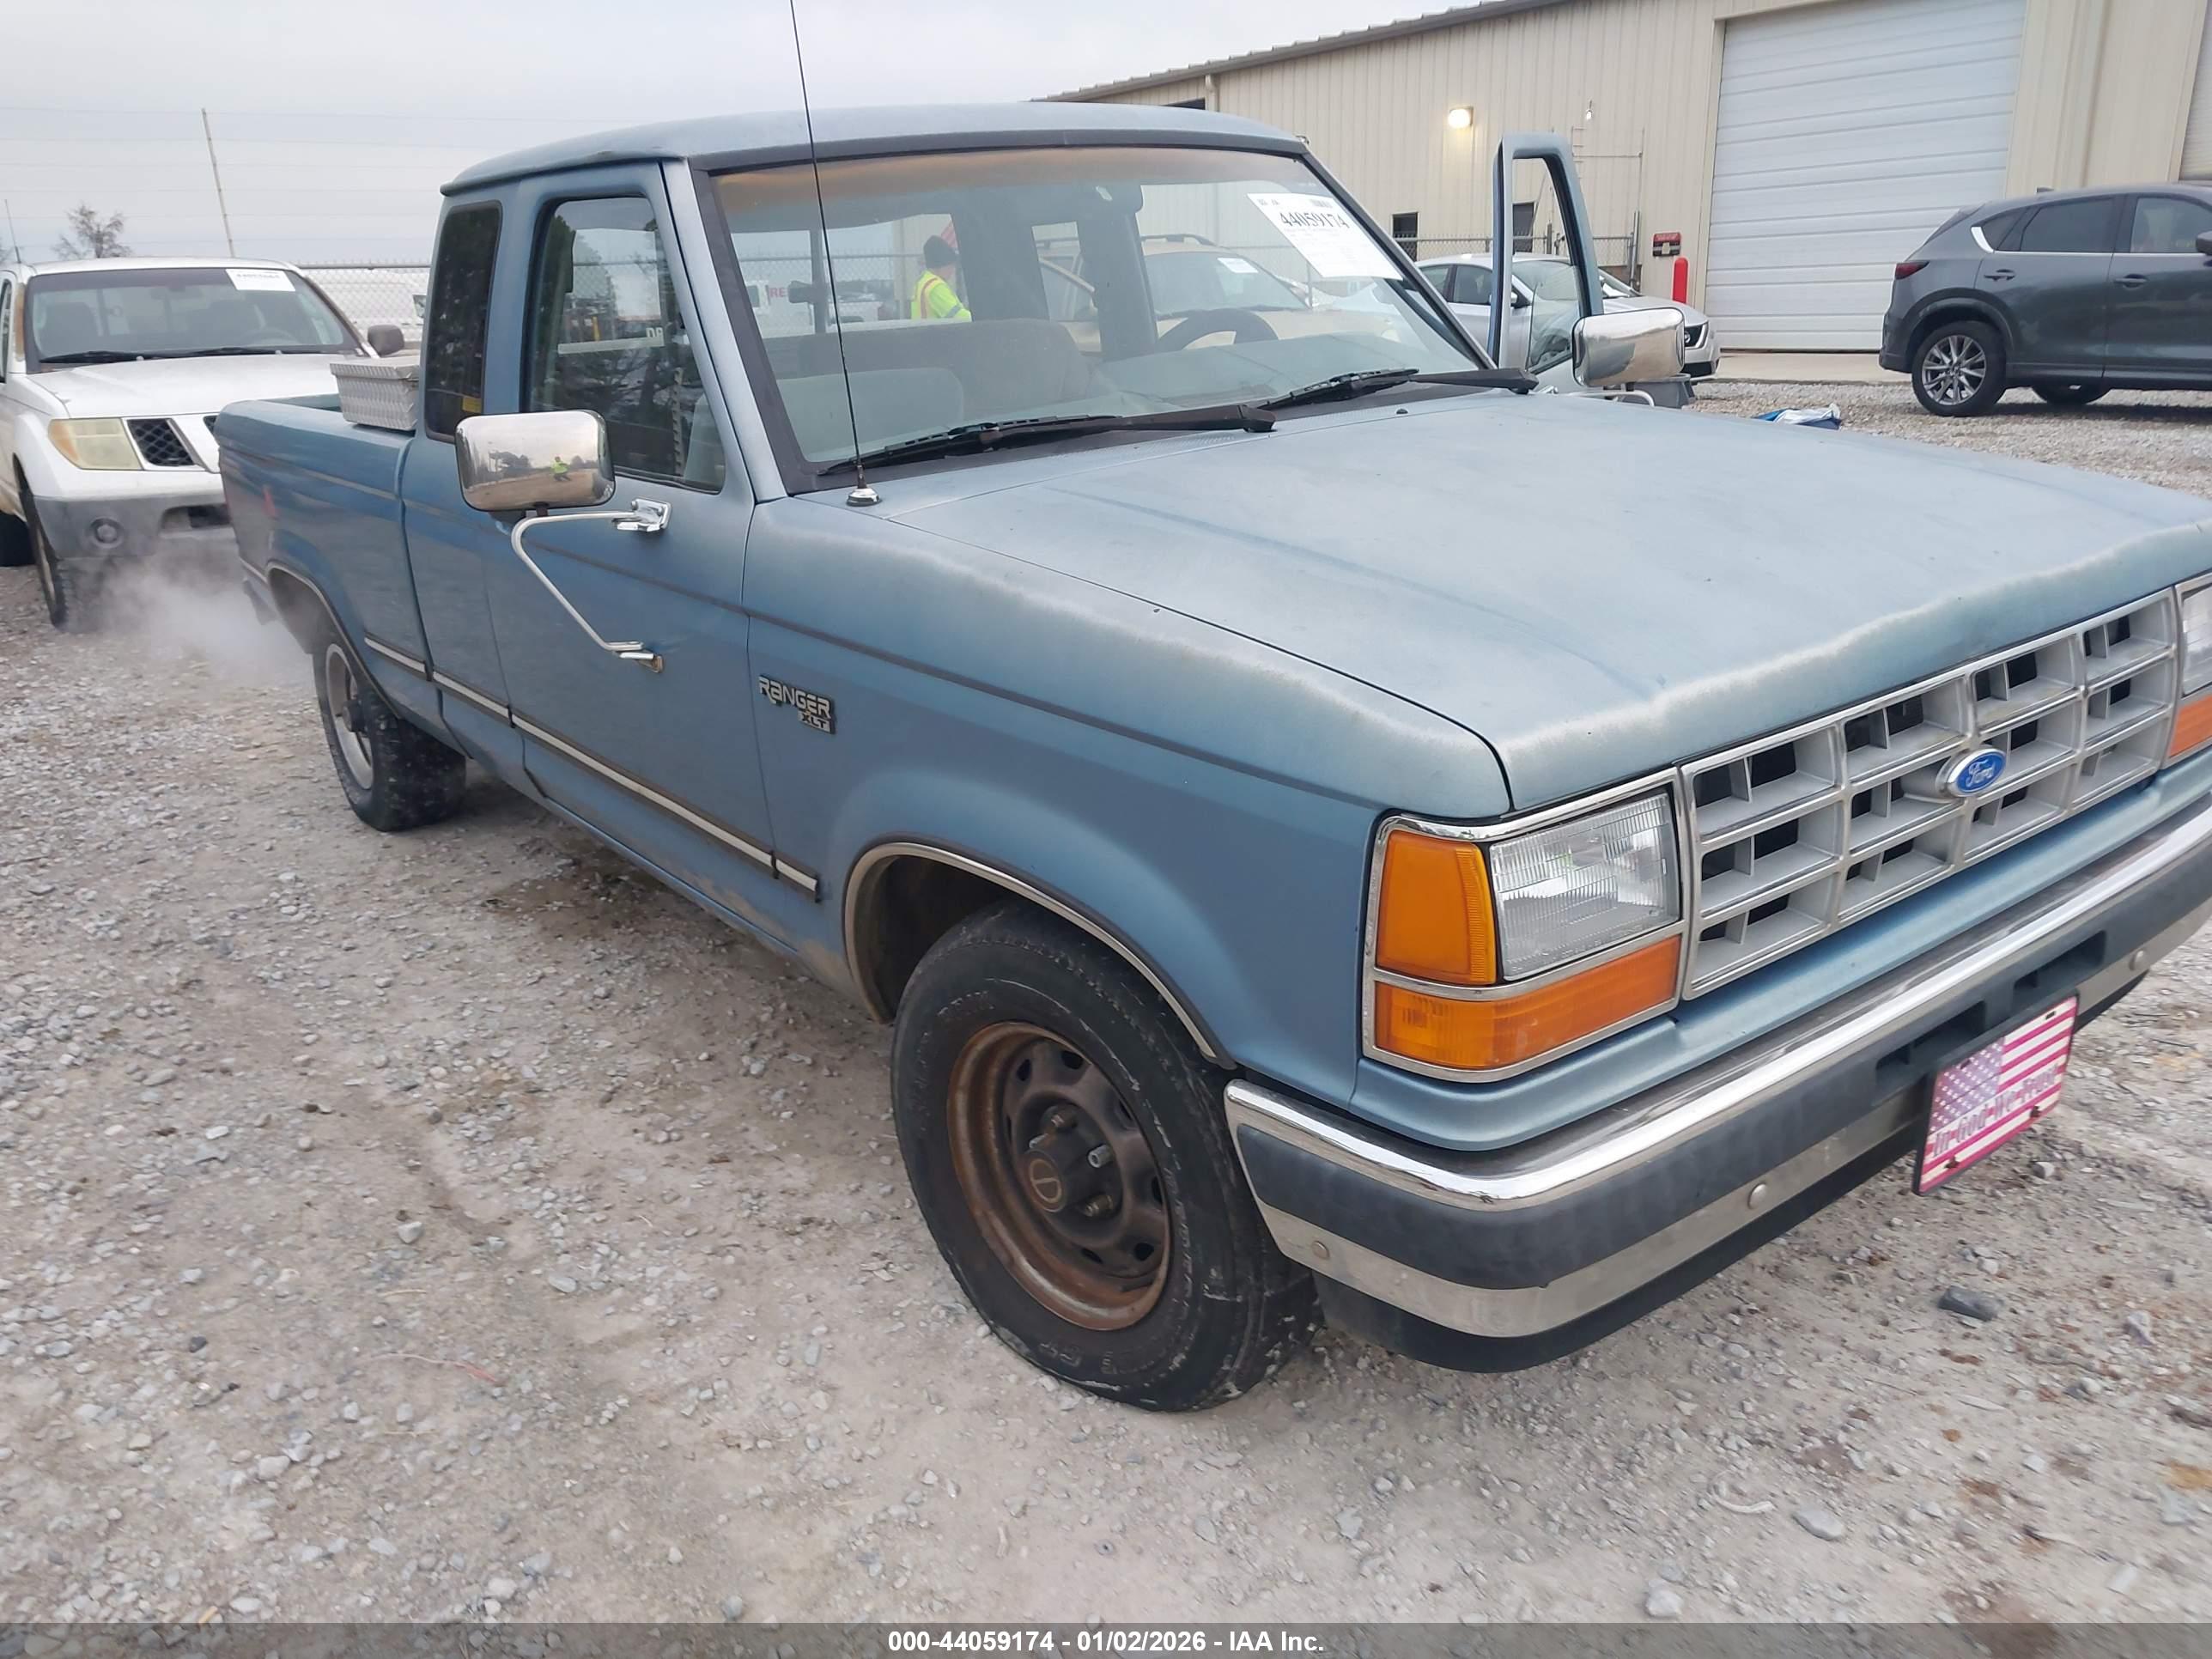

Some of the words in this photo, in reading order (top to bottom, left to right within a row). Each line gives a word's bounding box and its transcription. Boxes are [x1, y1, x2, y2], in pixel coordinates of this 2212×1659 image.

[1279, 212, 1350, 228] 44059174
[758, 674, 832, 720] RANGER
[801, 712, 827, 730] XLT
[1965, 758, 1996, 787] Ford
